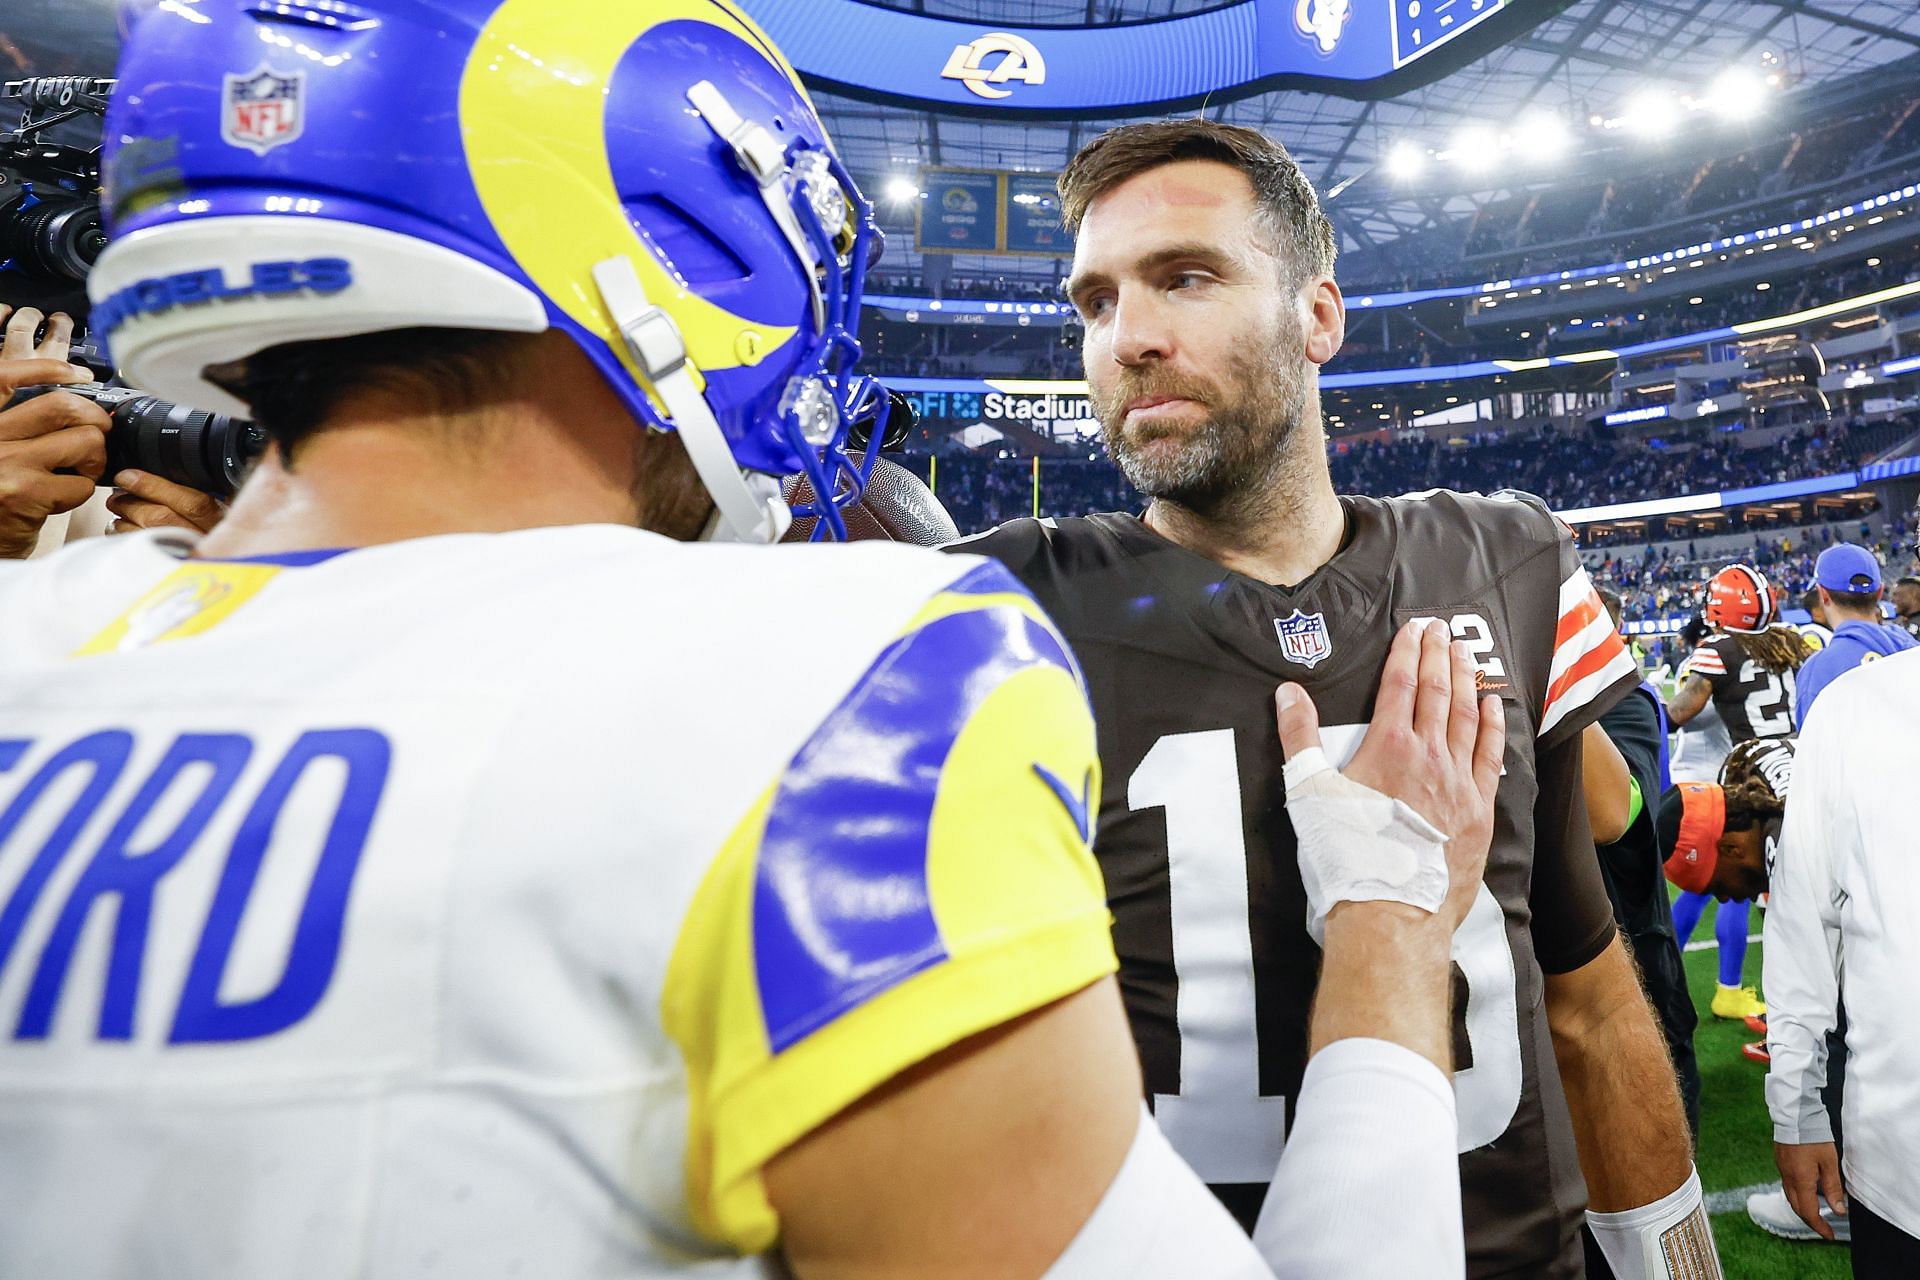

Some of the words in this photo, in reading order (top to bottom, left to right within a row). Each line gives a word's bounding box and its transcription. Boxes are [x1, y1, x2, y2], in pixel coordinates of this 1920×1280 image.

[232, 102, 293, 138] NFL
[1626, 242, 1712, 270] WELCOME
[1721, 234, 1746, 248] TO
[1755, 223, 1791, 240] THE
[985, 301, 1071, 315] WELCO
[96, 392, 120, 401] ONY
[1290, 632, 1324, 656] NFL
[1408, 613, 1506, 677] 2
[0, 727, 393, 1046] ORD
